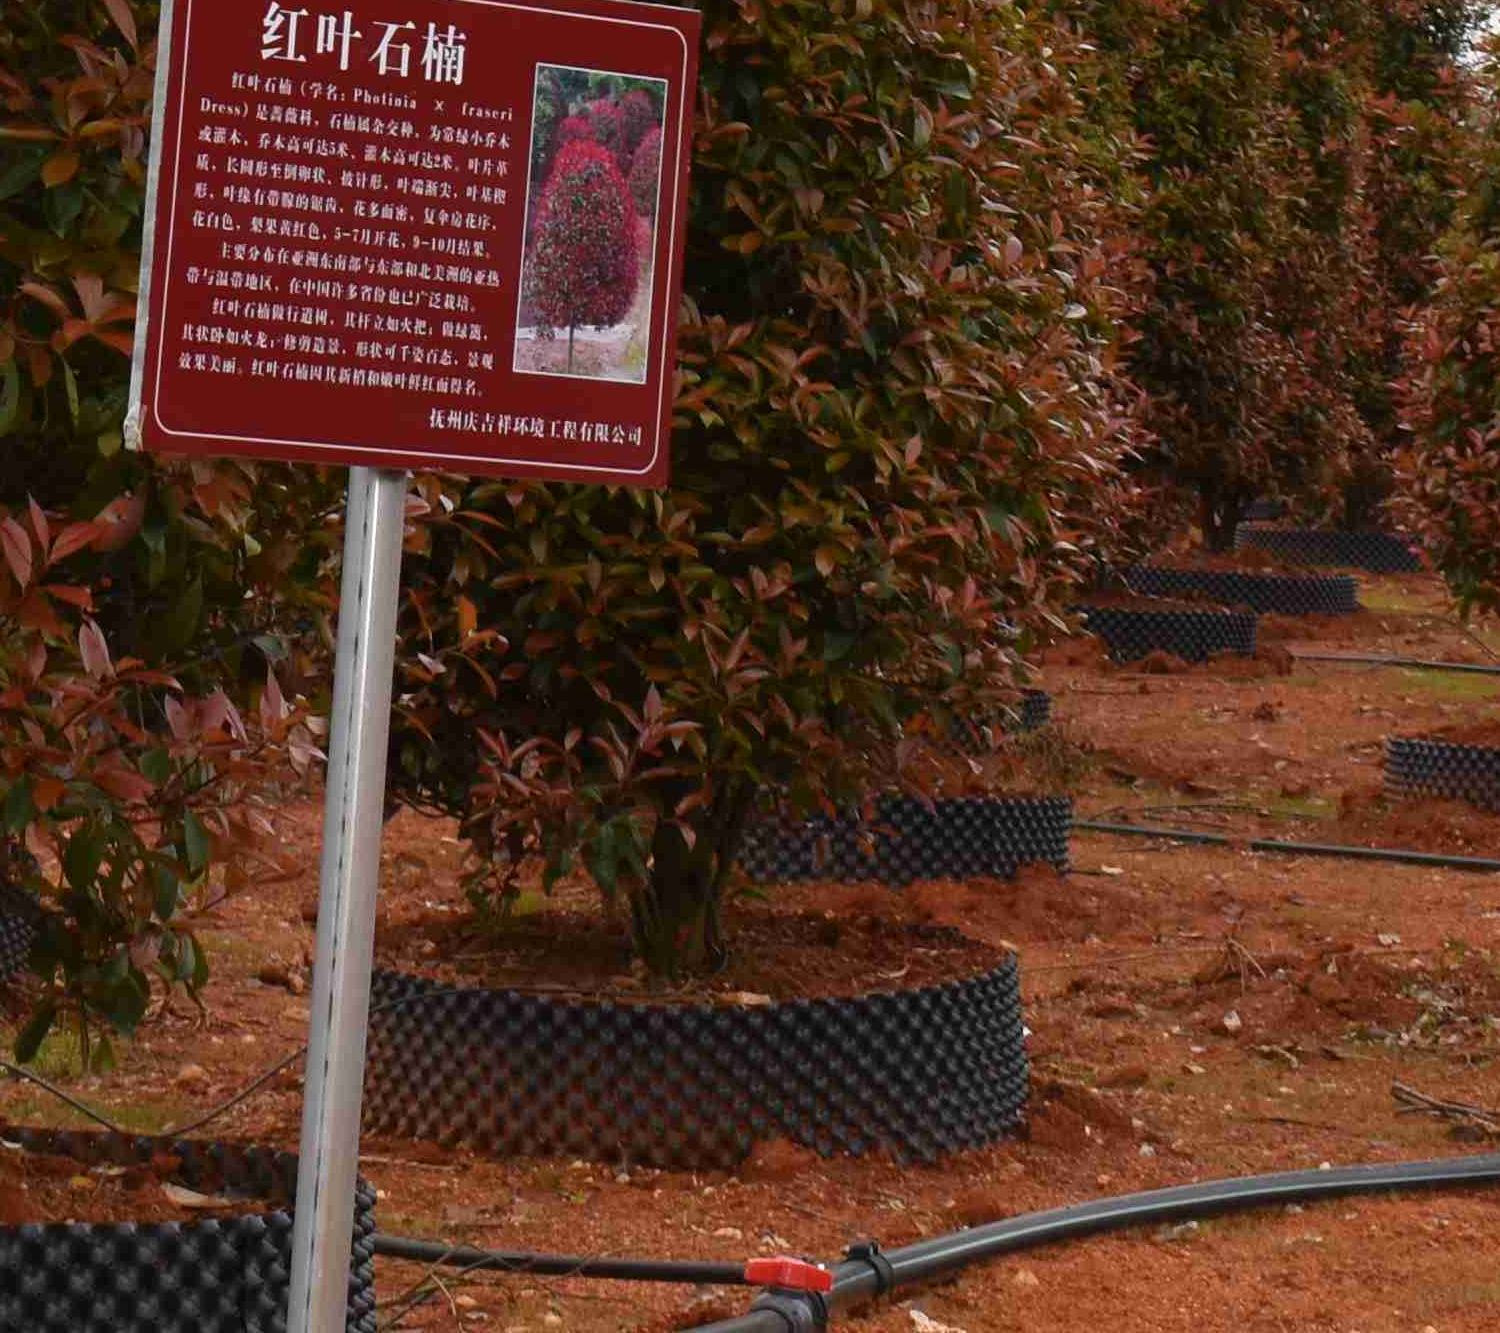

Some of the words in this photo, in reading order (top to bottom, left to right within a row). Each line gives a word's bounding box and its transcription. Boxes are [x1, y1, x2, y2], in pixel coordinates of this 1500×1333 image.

[260, 0, 467, 86] 红叶石楠
[461, 100, 515, 122] fraseri
[429, 407, 642, 446] 抚州庆吉祥环境工程有限公司
